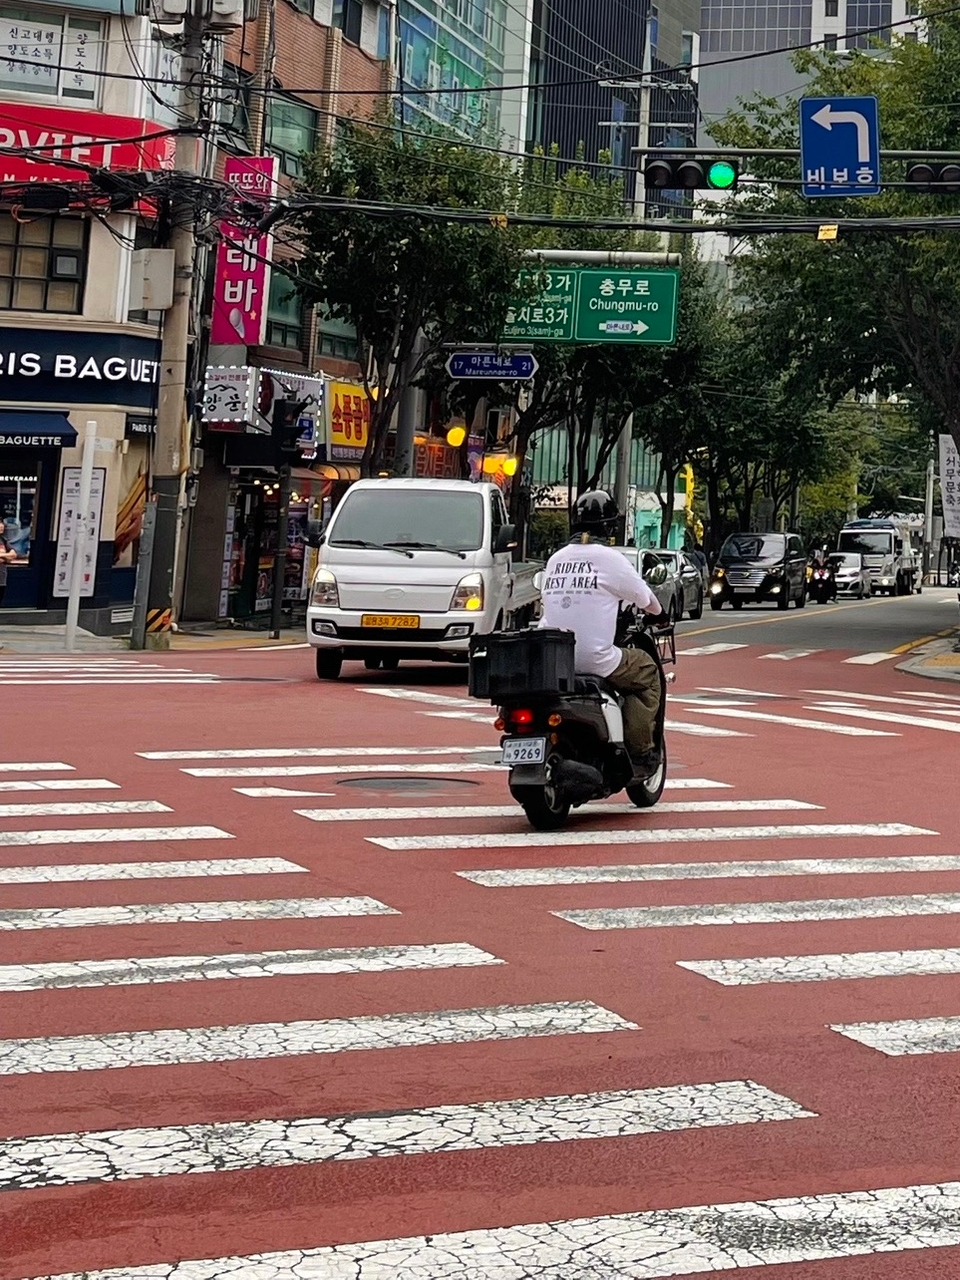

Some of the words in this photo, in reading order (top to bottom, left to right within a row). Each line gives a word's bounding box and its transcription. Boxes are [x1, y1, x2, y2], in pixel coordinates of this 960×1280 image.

[807, 166, 875, 190] 비보호
[599, 278, 650, 296] 충무로
[589, 298, 659, 313] Chungmu-ro
[0, 353, 41, 376] IS
[54, 355, 161, 383] BAGUET
[454, 361, 464, 369] 17
[471, 356, 513, 368] 마른내로
[521, 362, 531, 371] 21
[0, 436, 62, 446] BAGUETTE
[554, 561, 594, 574] RIDER'S
[544, 577, 567, 590] REST
[571, 576, 598, 589] AREA
[513, 748, 541, 760] 9269
